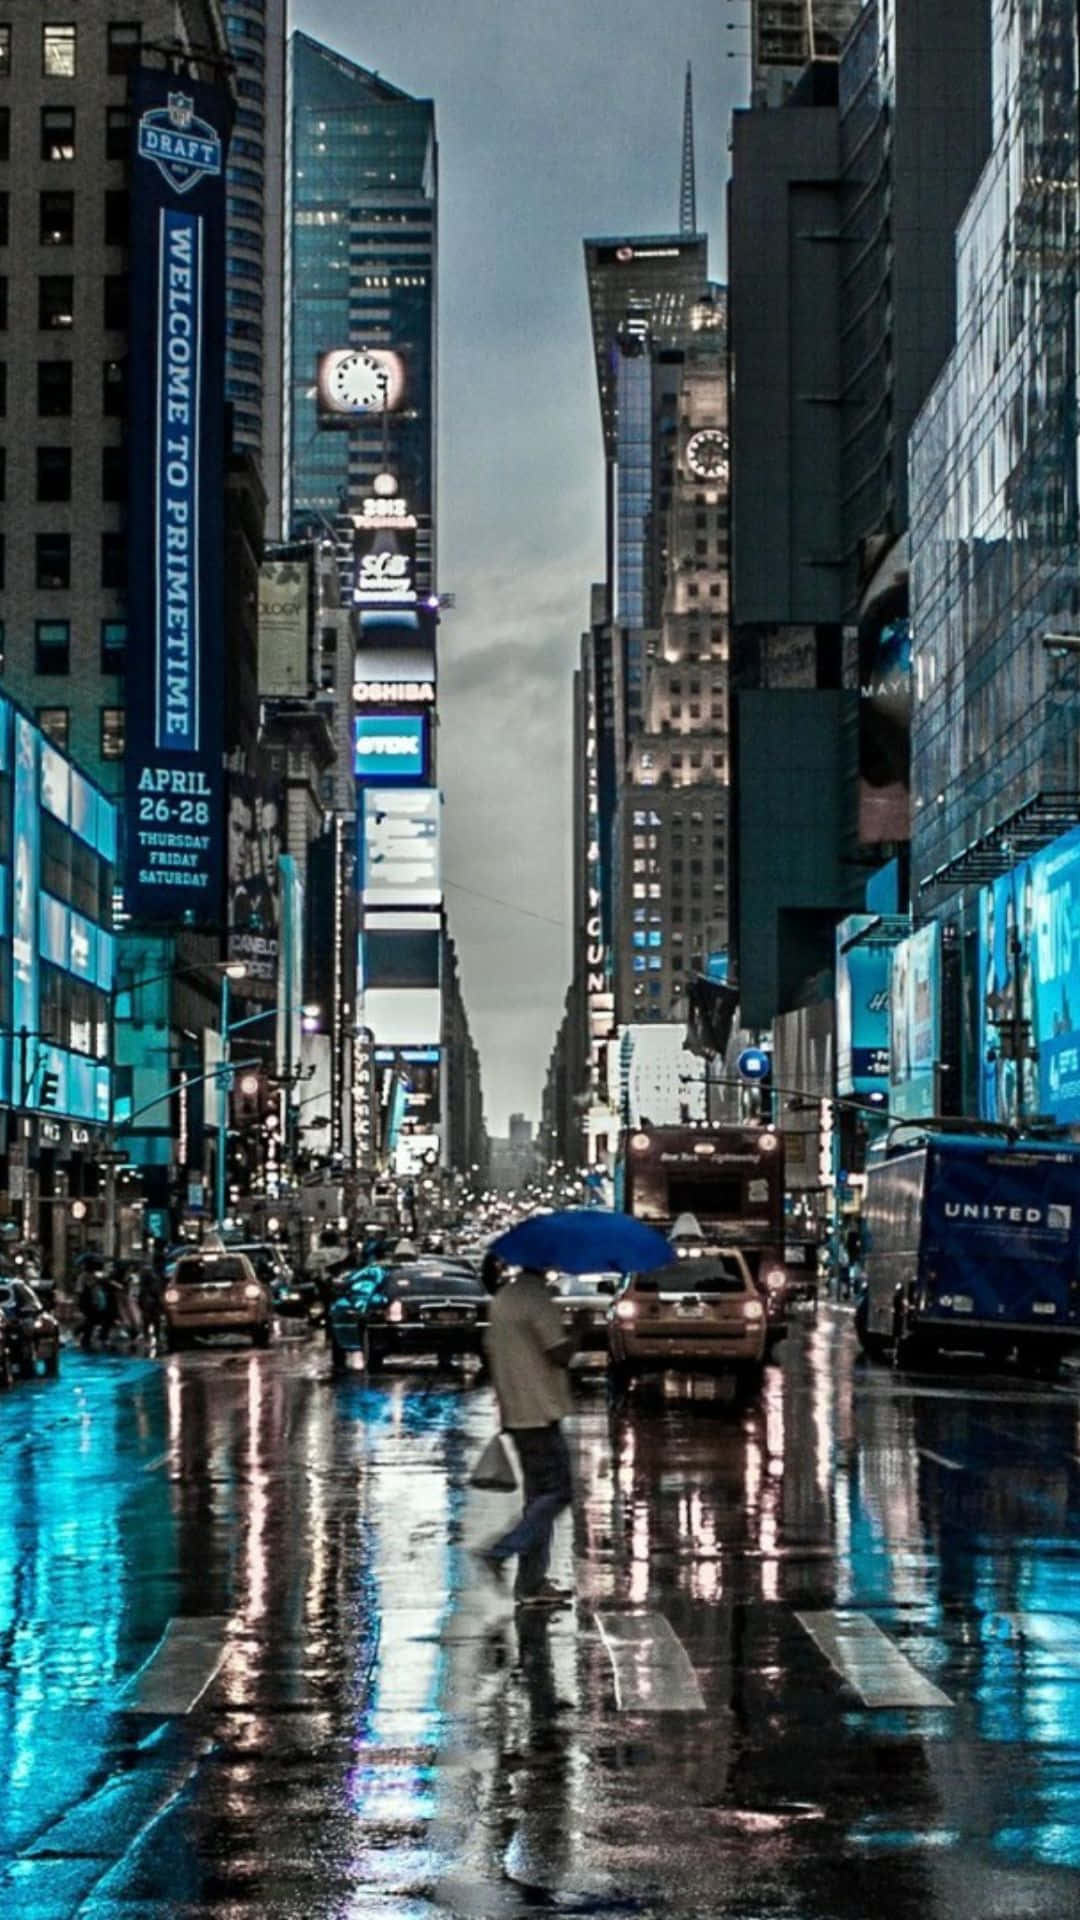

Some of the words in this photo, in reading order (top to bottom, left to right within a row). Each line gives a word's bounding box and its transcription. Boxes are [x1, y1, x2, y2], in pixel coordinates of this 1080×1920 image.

[146, 131, 214, 162] DRAFT
[167, 227, 193, 424] WELCOME
[167, 436, 189, 487] TO
[166, 499, 189, 735] PRIMETIME
[138, 768, 211, 795] APRIL
[139, 798, 209, 825] 26-28
[138, 832, 210, 848] THURSDAY
[150, 852, 198, 867] FRIDAY
[139, 870, 208, 887] SATURDAY
[945, 1202, 1041, 1222] UNITED
